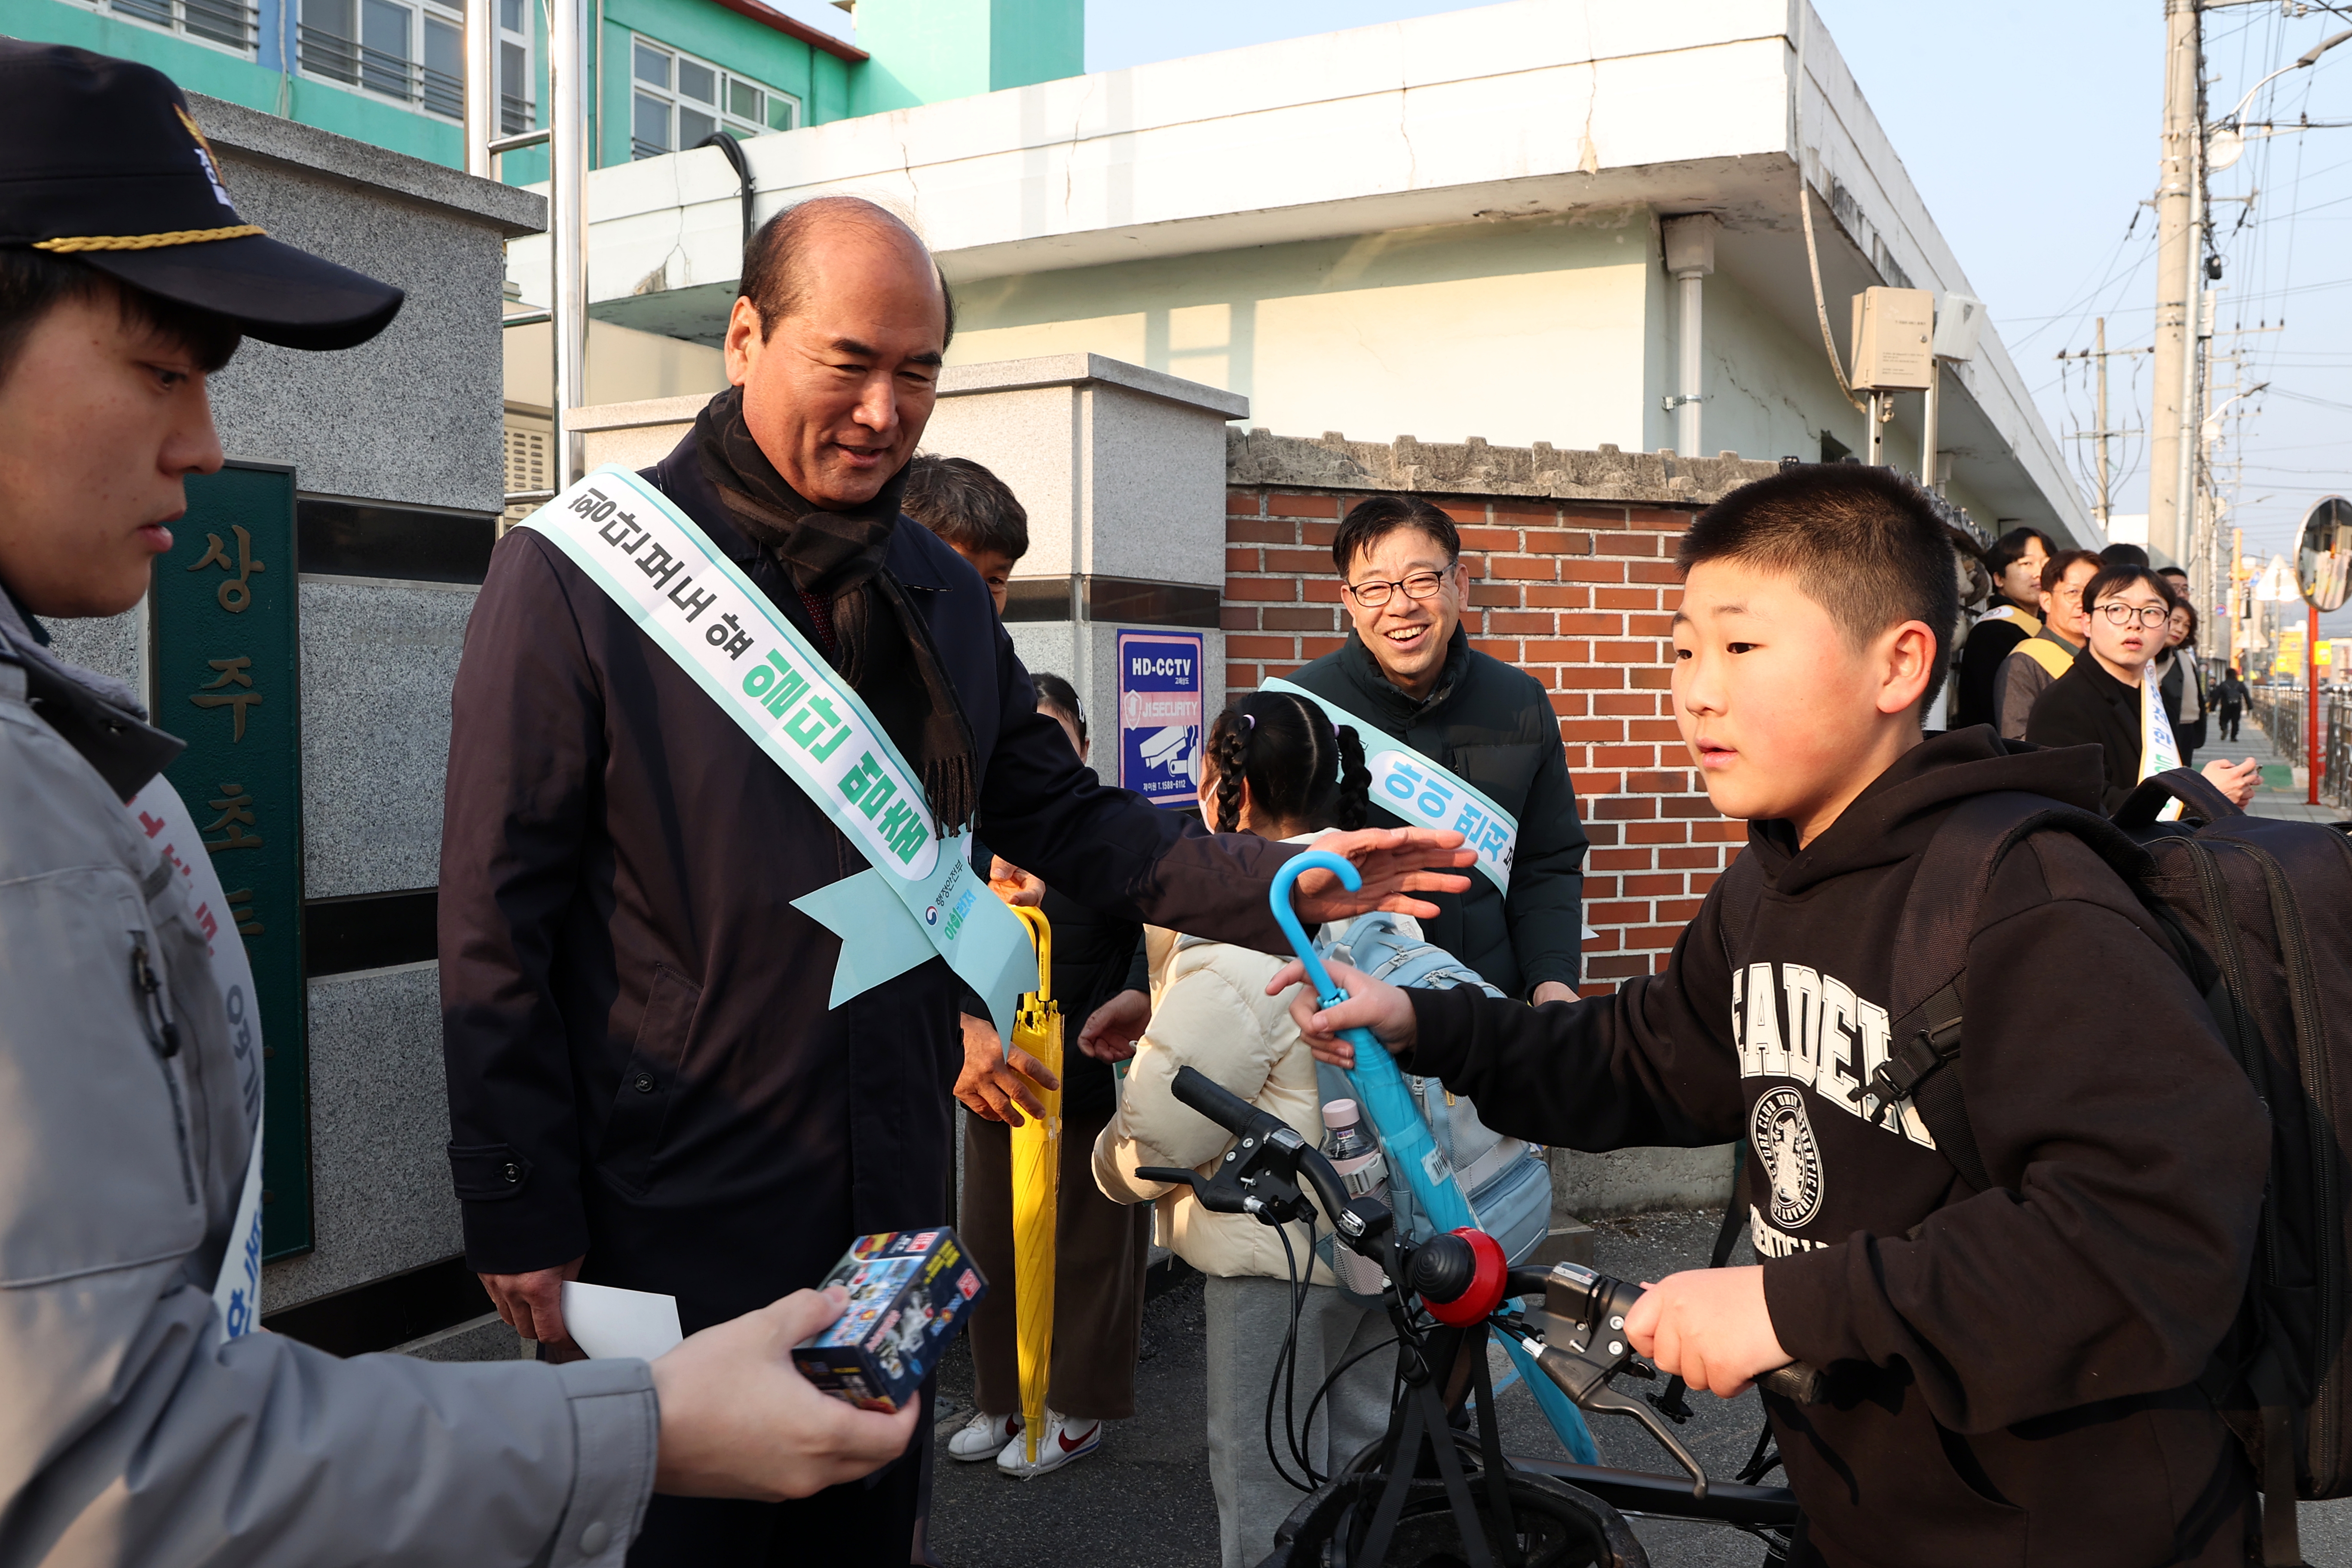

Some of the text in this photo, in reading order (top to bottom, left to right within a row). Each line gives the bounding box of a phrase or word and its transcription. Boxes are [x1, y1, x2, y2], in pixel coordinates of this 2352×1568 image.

[568, 487, 929, 866] 횡단보도 앞 일단 멈춤
[1132, 658, 1191, 676] HD-CCTV
[1143, 782, 1157, 792] 제이원
[1384, 761, 1454, 818] 아이
[1453, 802, 1510, 862] 먼저
[935, 859, 963, 906] 행정안전부
[1758, 1100, 1777, 1129] CLUB
